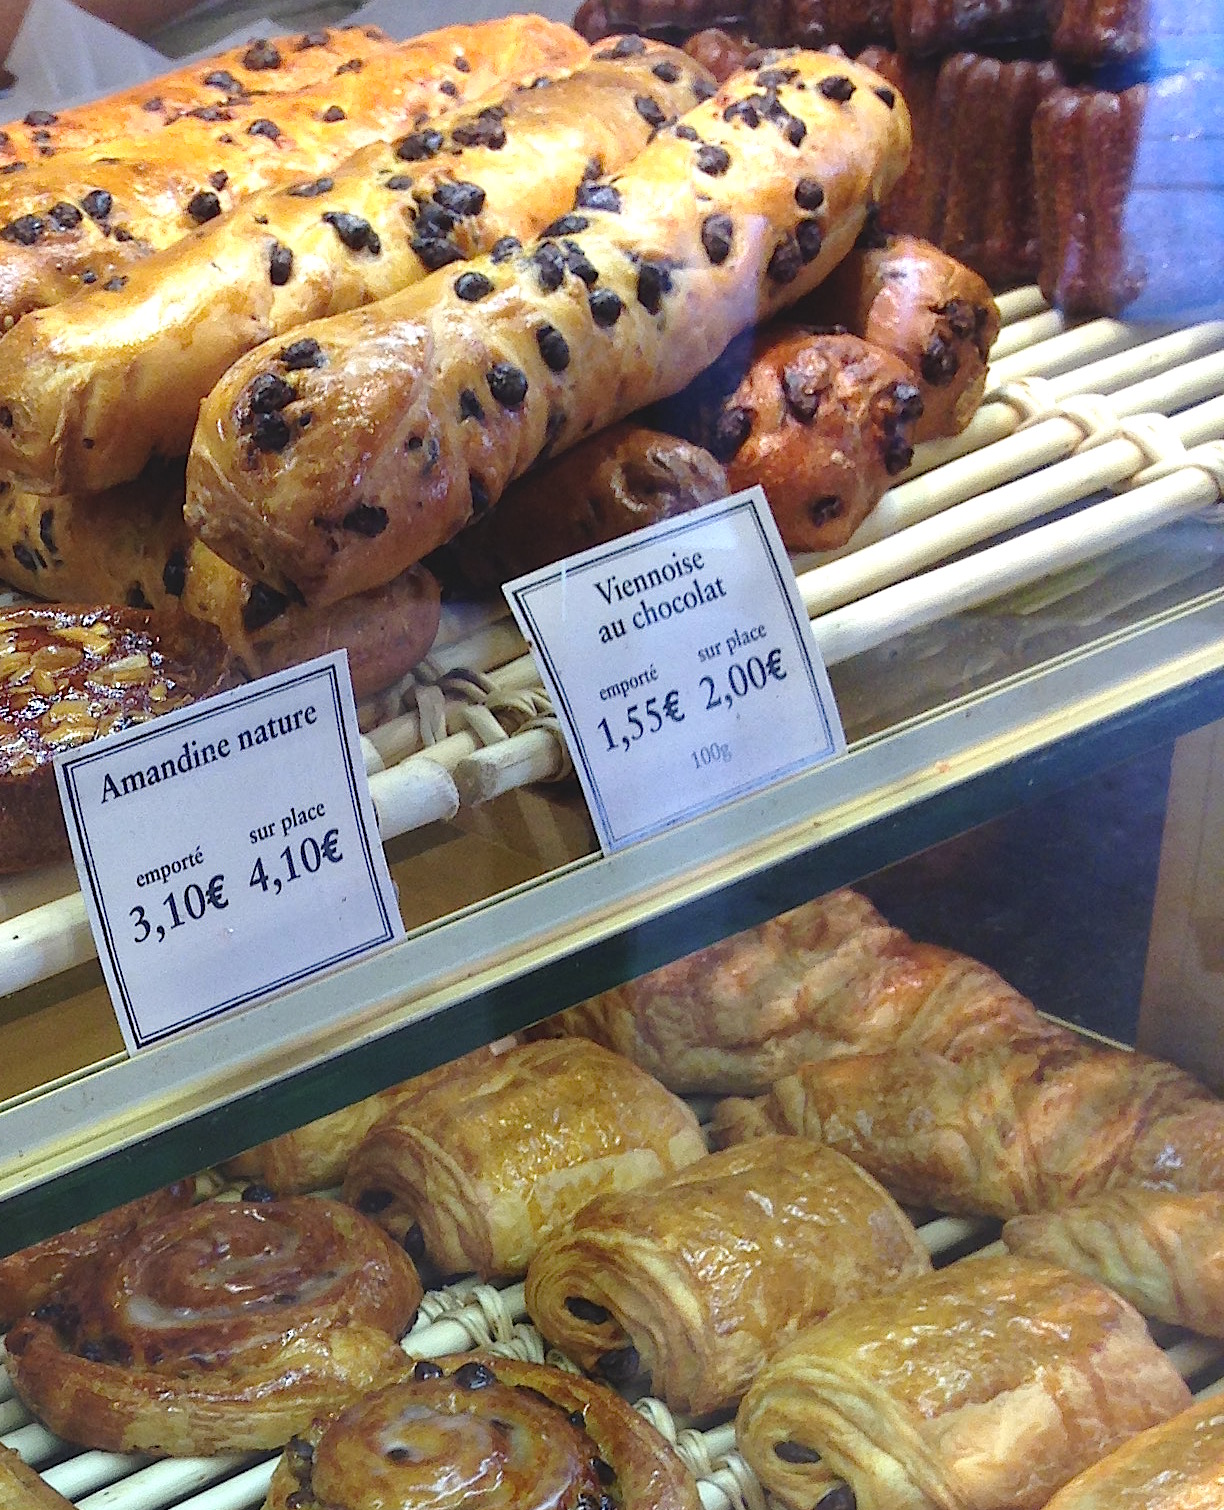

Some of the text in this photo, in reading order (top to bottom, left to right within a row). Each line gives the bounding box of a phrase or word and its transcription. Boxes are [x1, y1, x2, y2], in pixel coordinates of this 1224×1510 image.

[594, 550, 705, 605] Viennoise
[599, 576, 727, 644] au chocolat
[596, 649, 787, 753] 1,55€ 2,00€
[599, 623, 767, 702] emporté sur place
[101, 704, 318, 804] Amandine nature
[691, 741, 732, 769] 100g
[129, 829, 344, 943] 3,10€ 4,10€
[136, 802, 326, 888] emporté sur place
